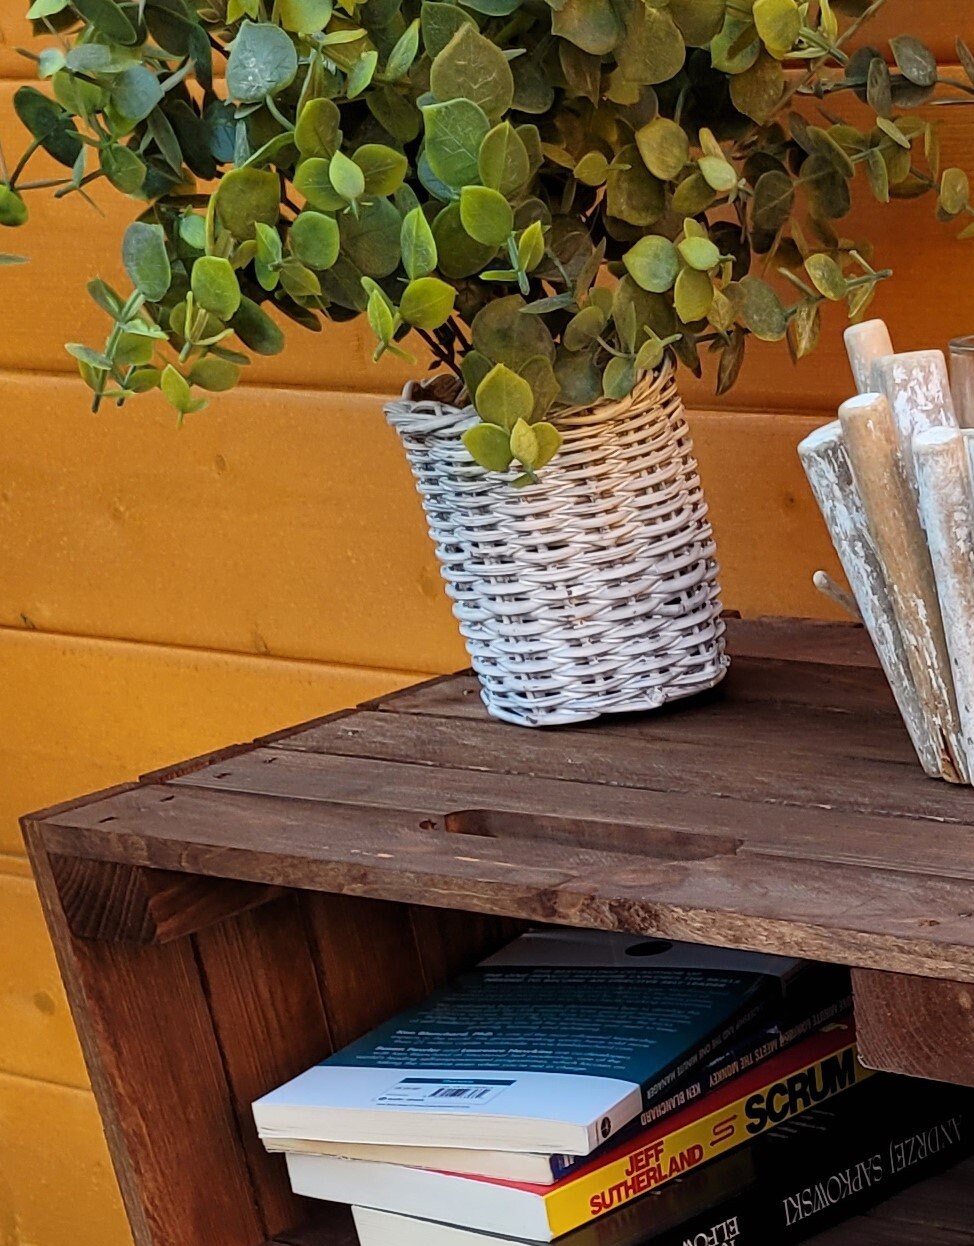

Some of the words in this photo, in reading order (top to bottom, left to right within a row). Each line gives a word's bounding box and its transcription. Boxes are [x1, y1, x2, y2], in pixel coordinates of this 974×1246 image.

[740, 1053, 754, 1070] THE
[755, 1040, 779, 1061] MEETS
[647, 1070, 676, 1100] MANAGER
[686, 1082, 701, 1100] KEN
[709, 1061, 739, 1088] MONKEY
[744, 1049, 856, 1134] SCRUM
[640, 1091, 686, 1126] BLANCHARD
[625, 1140, 665, 1177] JEFF
[889, 1114, 964, 1174] ANDRZEJ
[590, 1143, 704, 1216] SUTHERLAND
[782, 1154, 883, 1227] SAPKOWSKI
